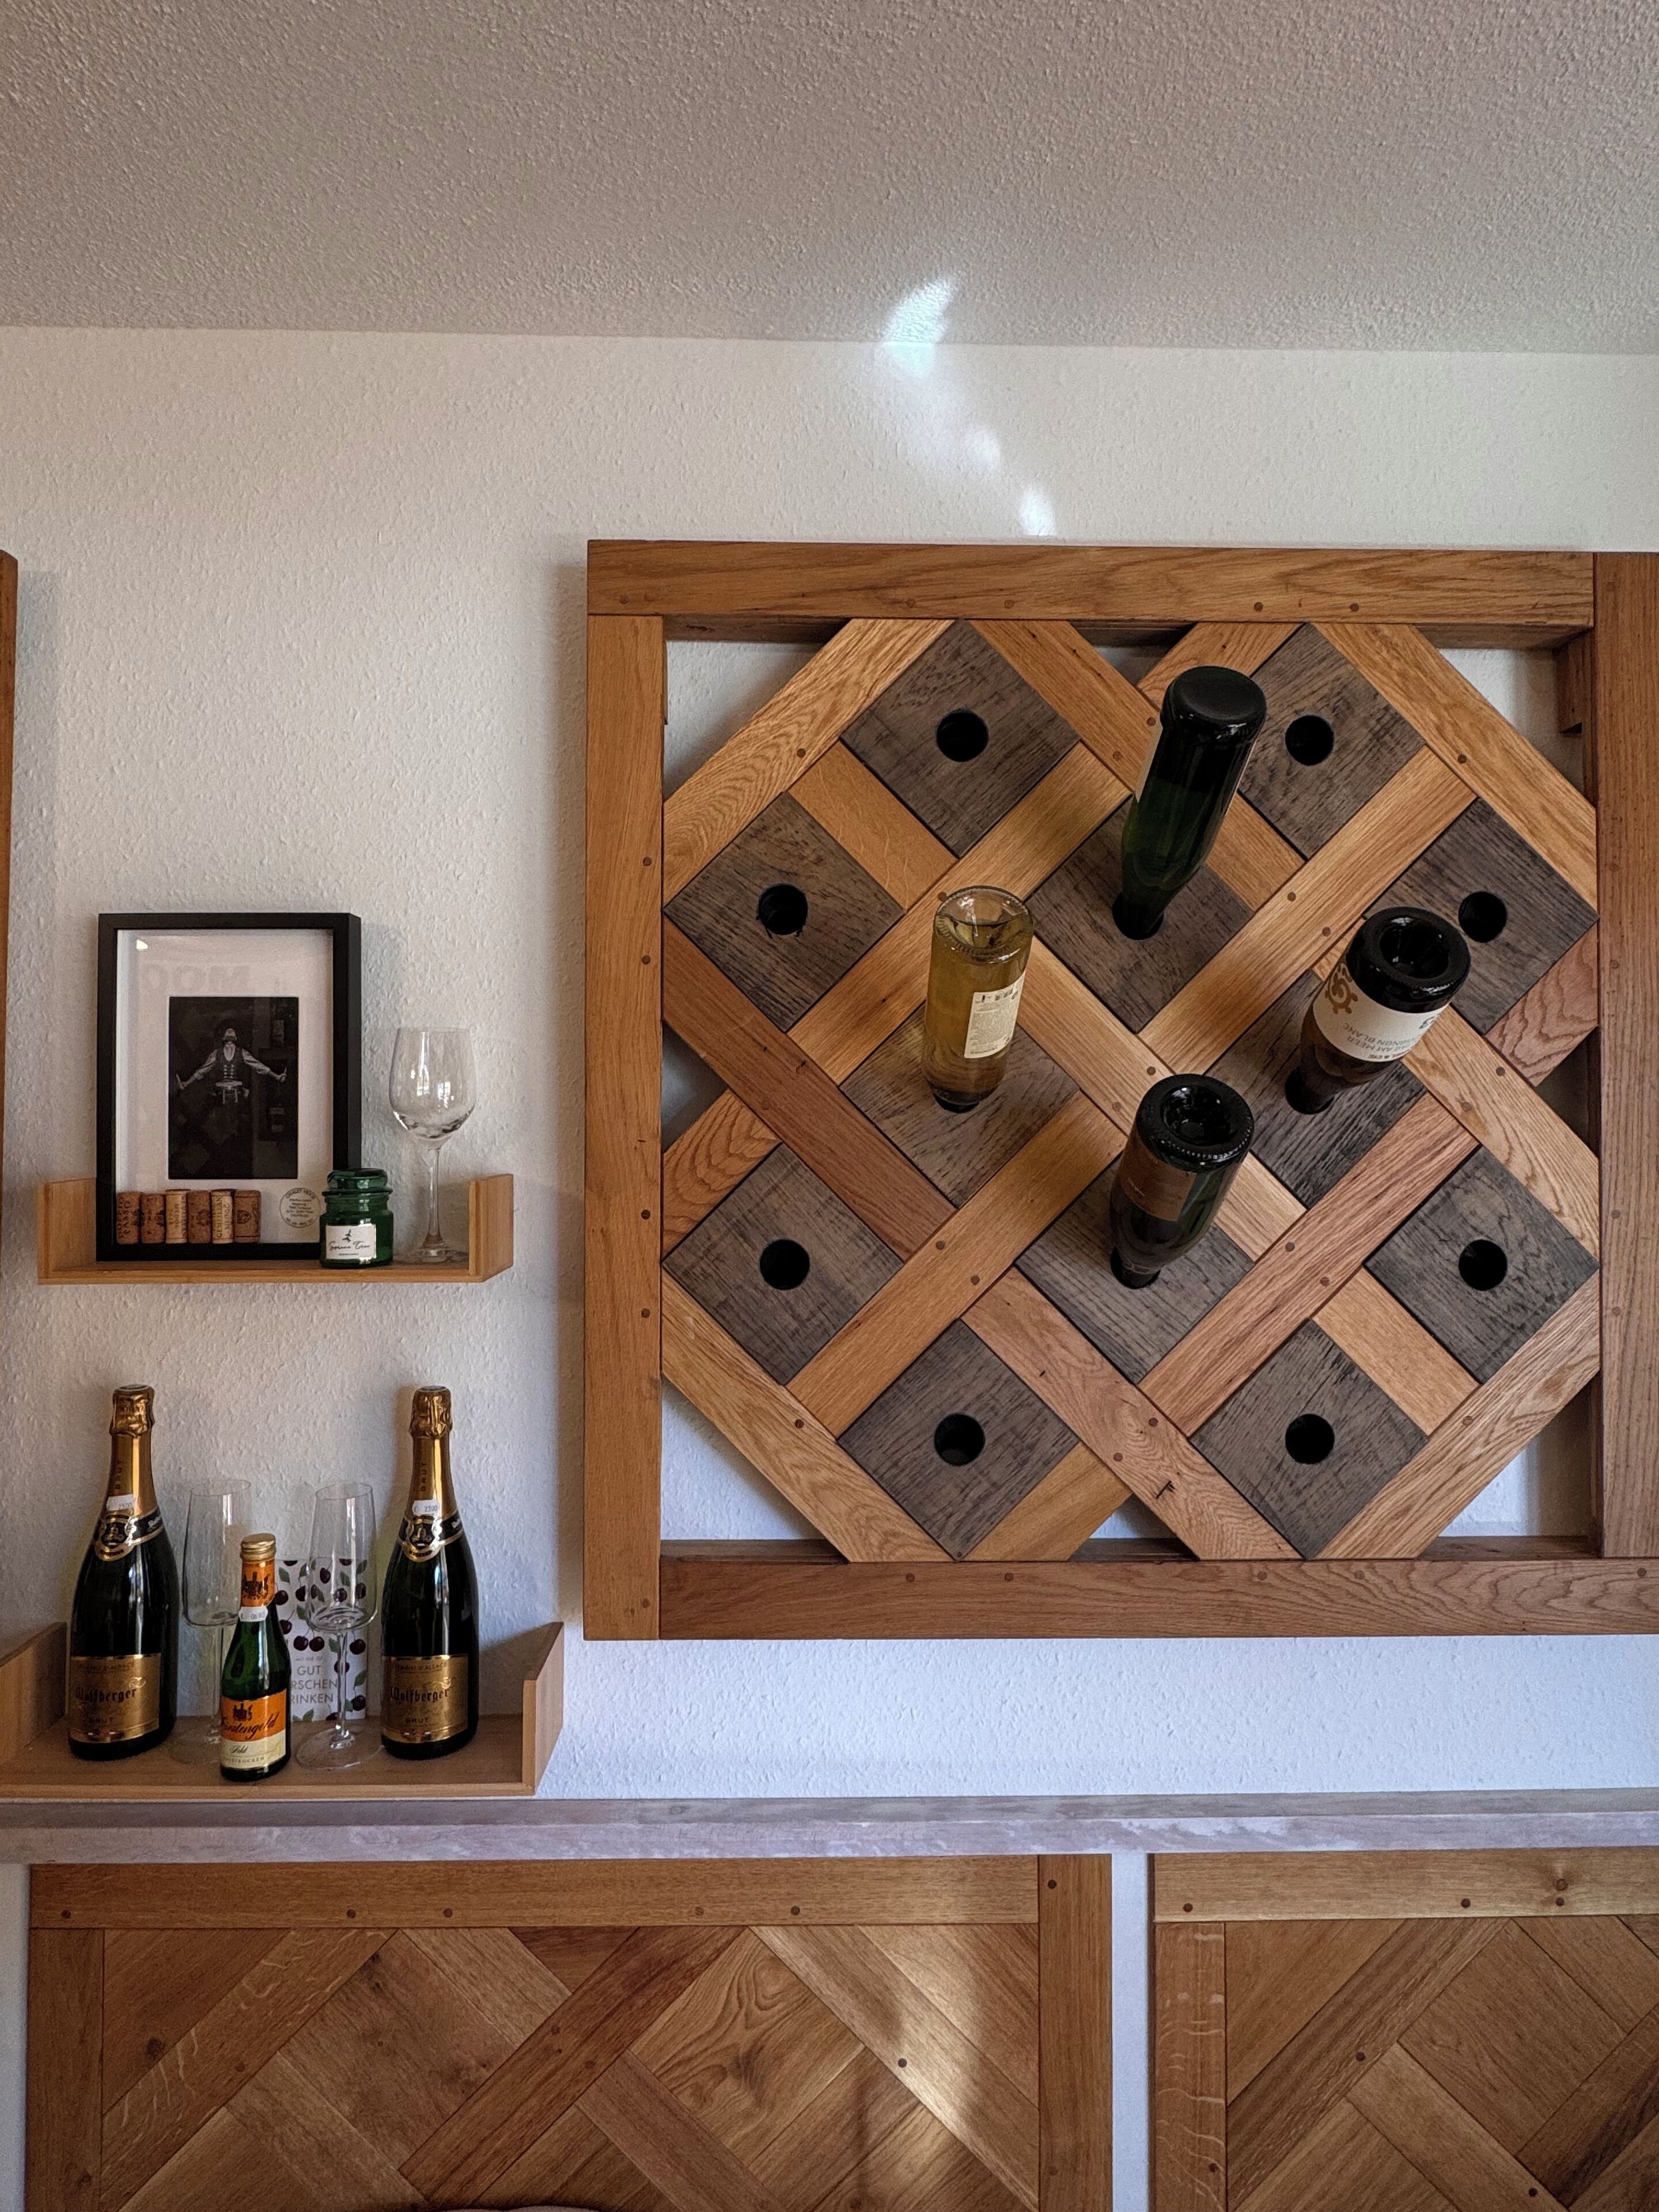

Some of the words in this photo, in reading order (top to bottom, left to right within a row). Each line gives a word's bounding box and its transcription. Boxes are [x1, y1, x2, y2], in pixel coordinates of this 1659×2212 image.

[1343, 1022, 1376, 1042] BLANC
[1346, 1035, 1376, 1050] MEER
[297, 1665, 321, 1676] GUT
[291, 1679, 338, 1690] RSCHEN
[291, 1693, 334, 1705] RINKEN
